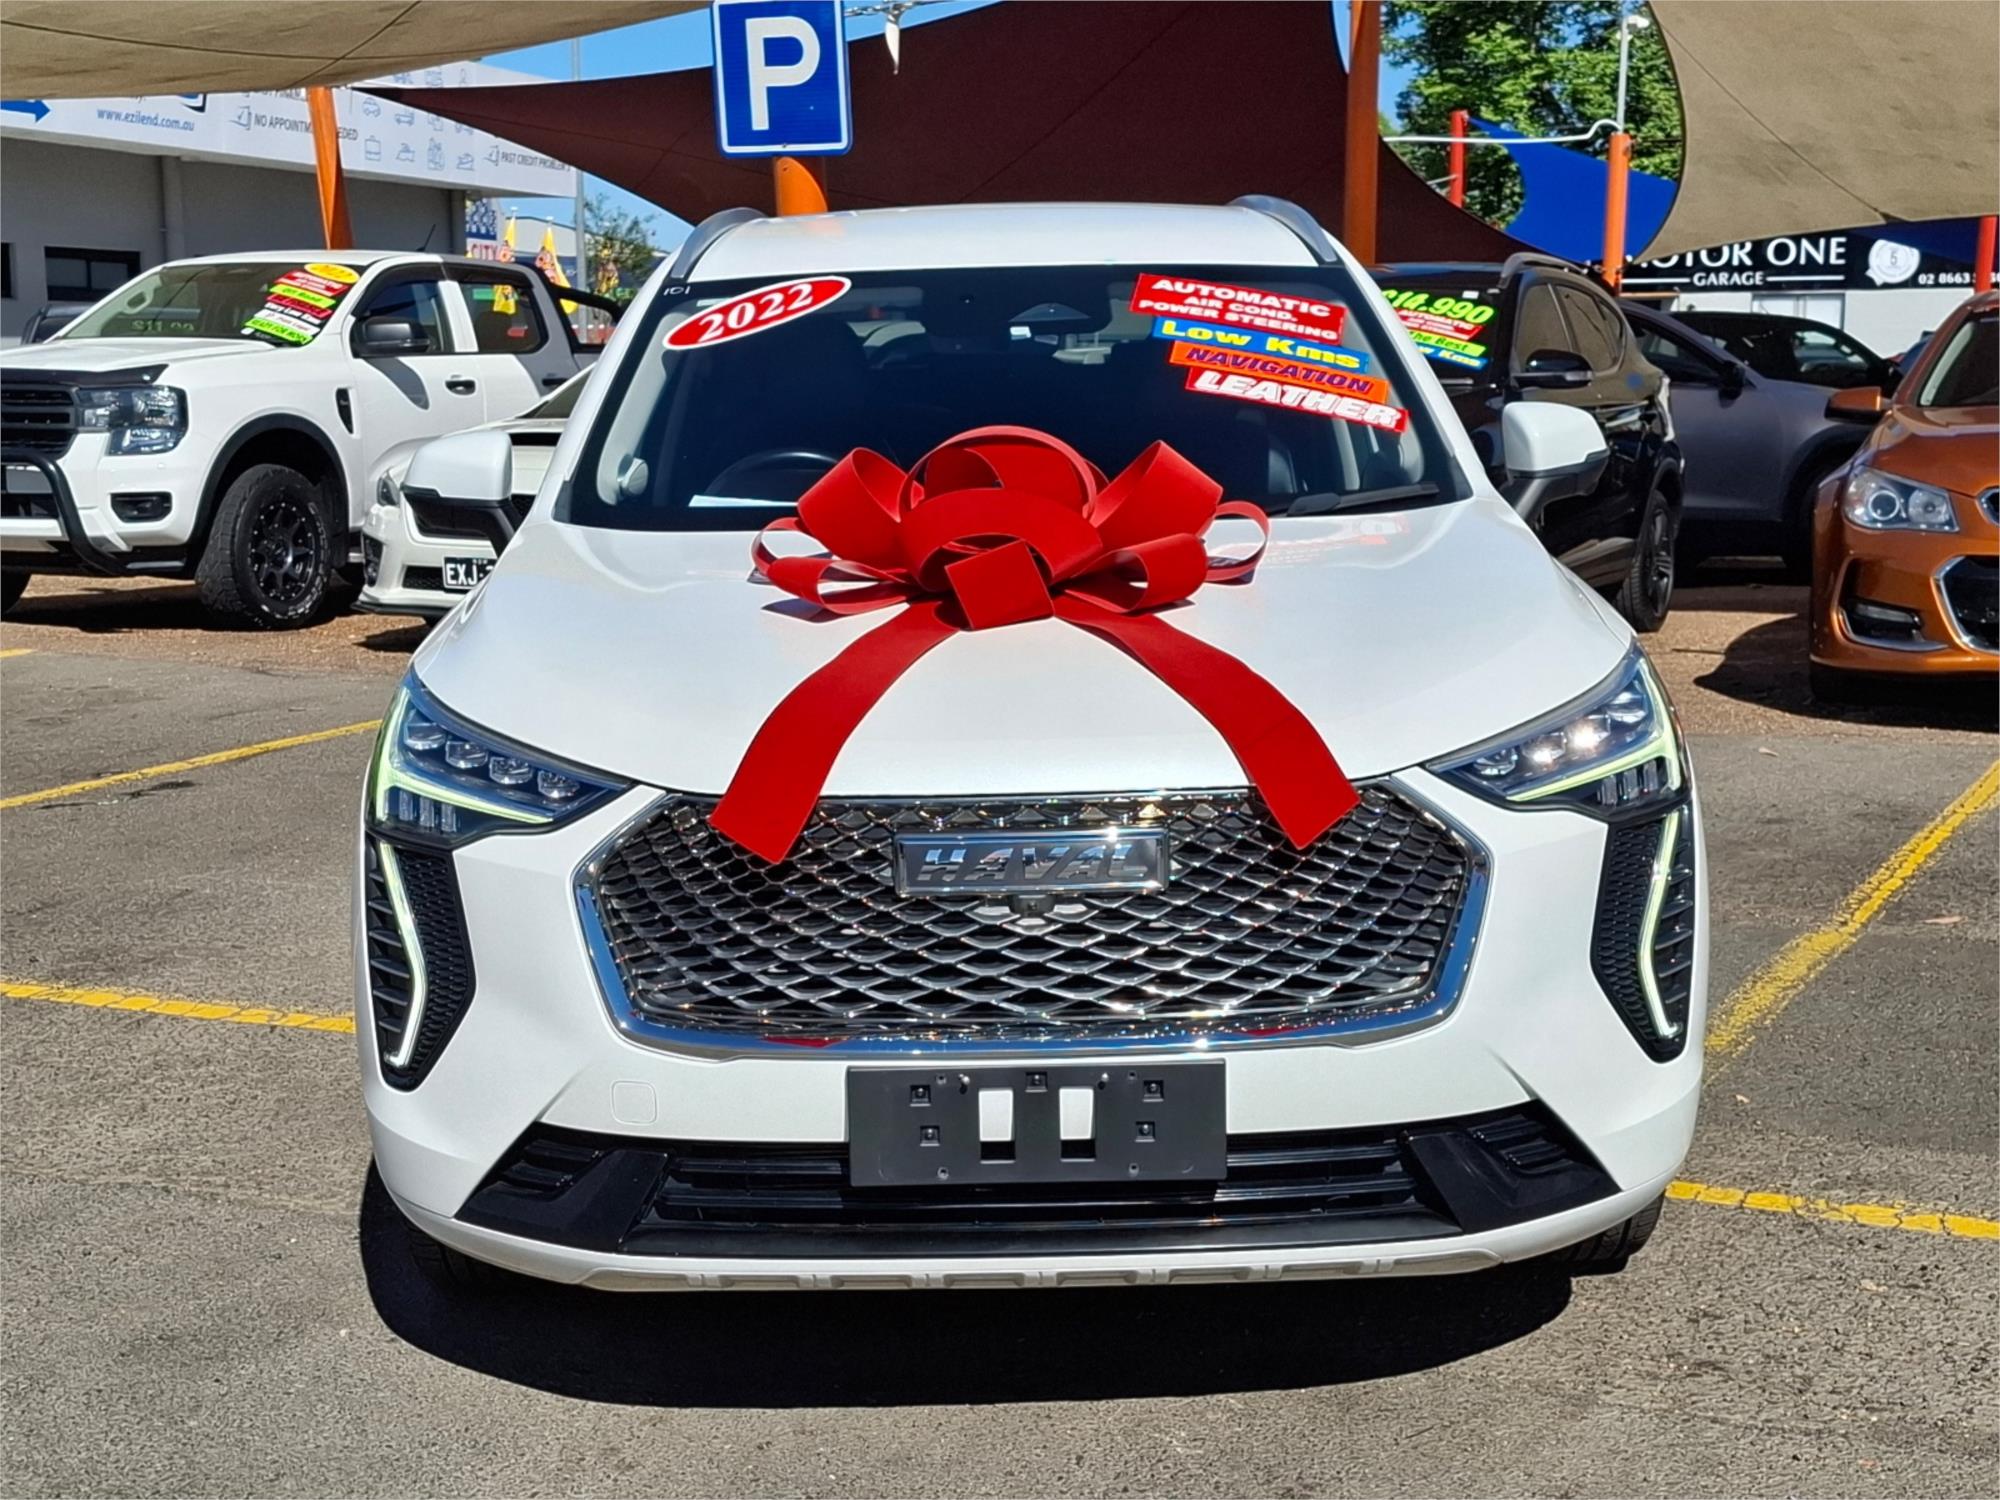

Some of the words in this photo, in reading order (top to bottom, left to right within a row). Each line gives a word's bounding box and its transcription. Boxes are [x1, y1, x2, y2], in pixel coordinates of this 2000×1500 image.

[745, 16, 820, 131] P
[97, 108, 195, 131] www.ezilend.com.au
[254, 113, 267, 127] NO
[269, 115, 313, 133] APPOINTM
[338, 127, 358, 141] EDED
[1766, 237, 1847, 266] ONE
[1693, 271, 1764, 287] GARAGE
[1918, 273, 1935, 285] 02
[1938, 272, 1971, 284] 8663
[697, 283, 814, 343] 2022
[1151, 279, 1331, 317] AUTOMATIC
[1183, 296, 1223, 310] AIR
[1228, 303, 1299, 322] COND.
[1138, 299, 1219, 319] POWER
[1224, 312, 1338, 340] STEERING
[1187, 347, 1374, 394] NAVIGATION
[1193, 371, 1402, 429] LEATHER
[917, 845, 1148, 882] HAVAL
